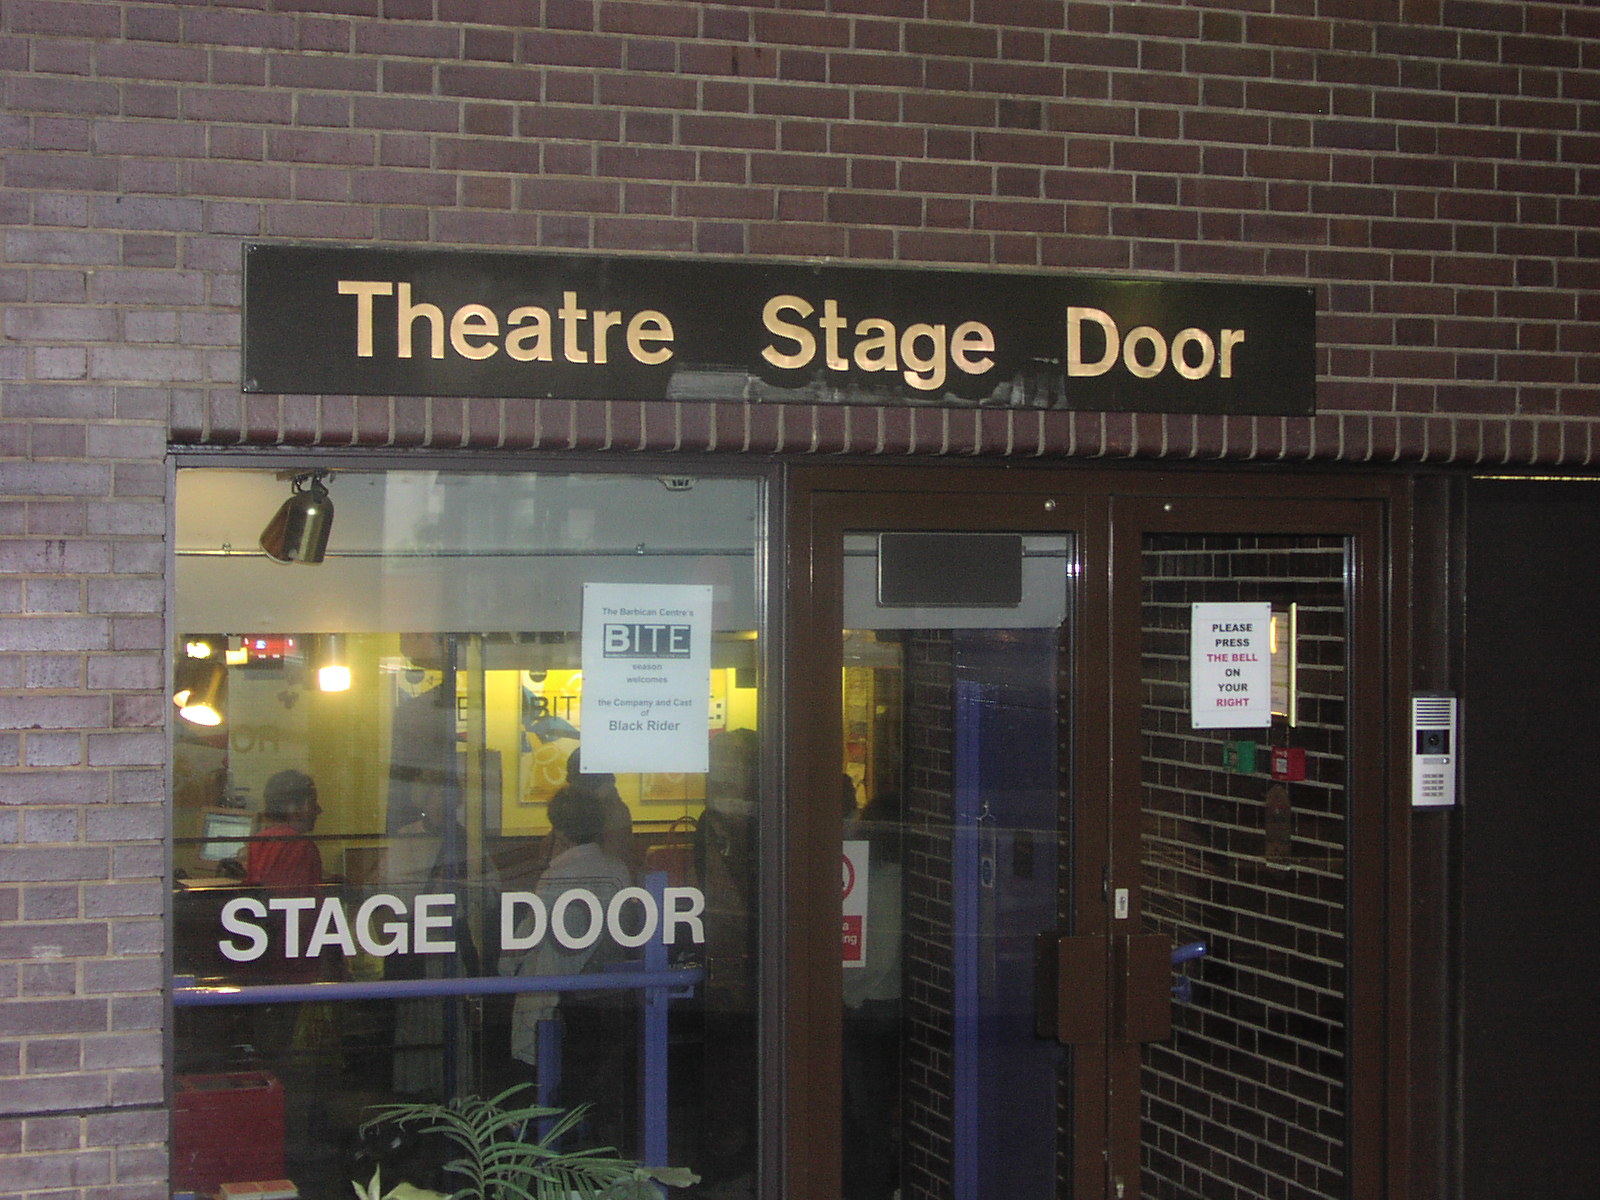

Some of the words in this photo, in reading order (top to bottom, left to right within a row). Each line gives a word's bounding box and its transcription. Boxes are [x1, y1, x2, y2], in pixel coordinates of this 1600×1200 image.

[337, 280, 675, 366] Theatre
[761, 294, 996, 391] Stage
[1066, 306, 1245, 380] Door
[602, 607, 618, 616] The
[619, 607, 657, 616] Barbican
[659, 608, 694, 617] Centre's
[1212, 624, 1252, 632] PLEASE
[605, 624, 689, 653] BITE
[1215, 639, 1249, 647] PRESS
[1207, 654, 1228, 662] THE
[1231, 653, 1258, 662] BELL
[1225, 669, 1240, 677] ON
[626, 675, 668, 684] welcomes
[1218, 684, 1248, 692] YOUR
[598, 699, 612, 707] the
[613, 698, 653, 708] Company
[655, 699, 671, 707] and
[673, 699, 692, 707] Cast
[1216, 698, 1249, 707] RIGHT
[530, 695, 581, 721] BIT
[640, 709, 650, 717] of
[609, 720, 643, 731] Black
[646, 720, 681, 731] Rider
[219, 893, 457, 962] STAGE
[500, 886, 706, 950] DOOR
